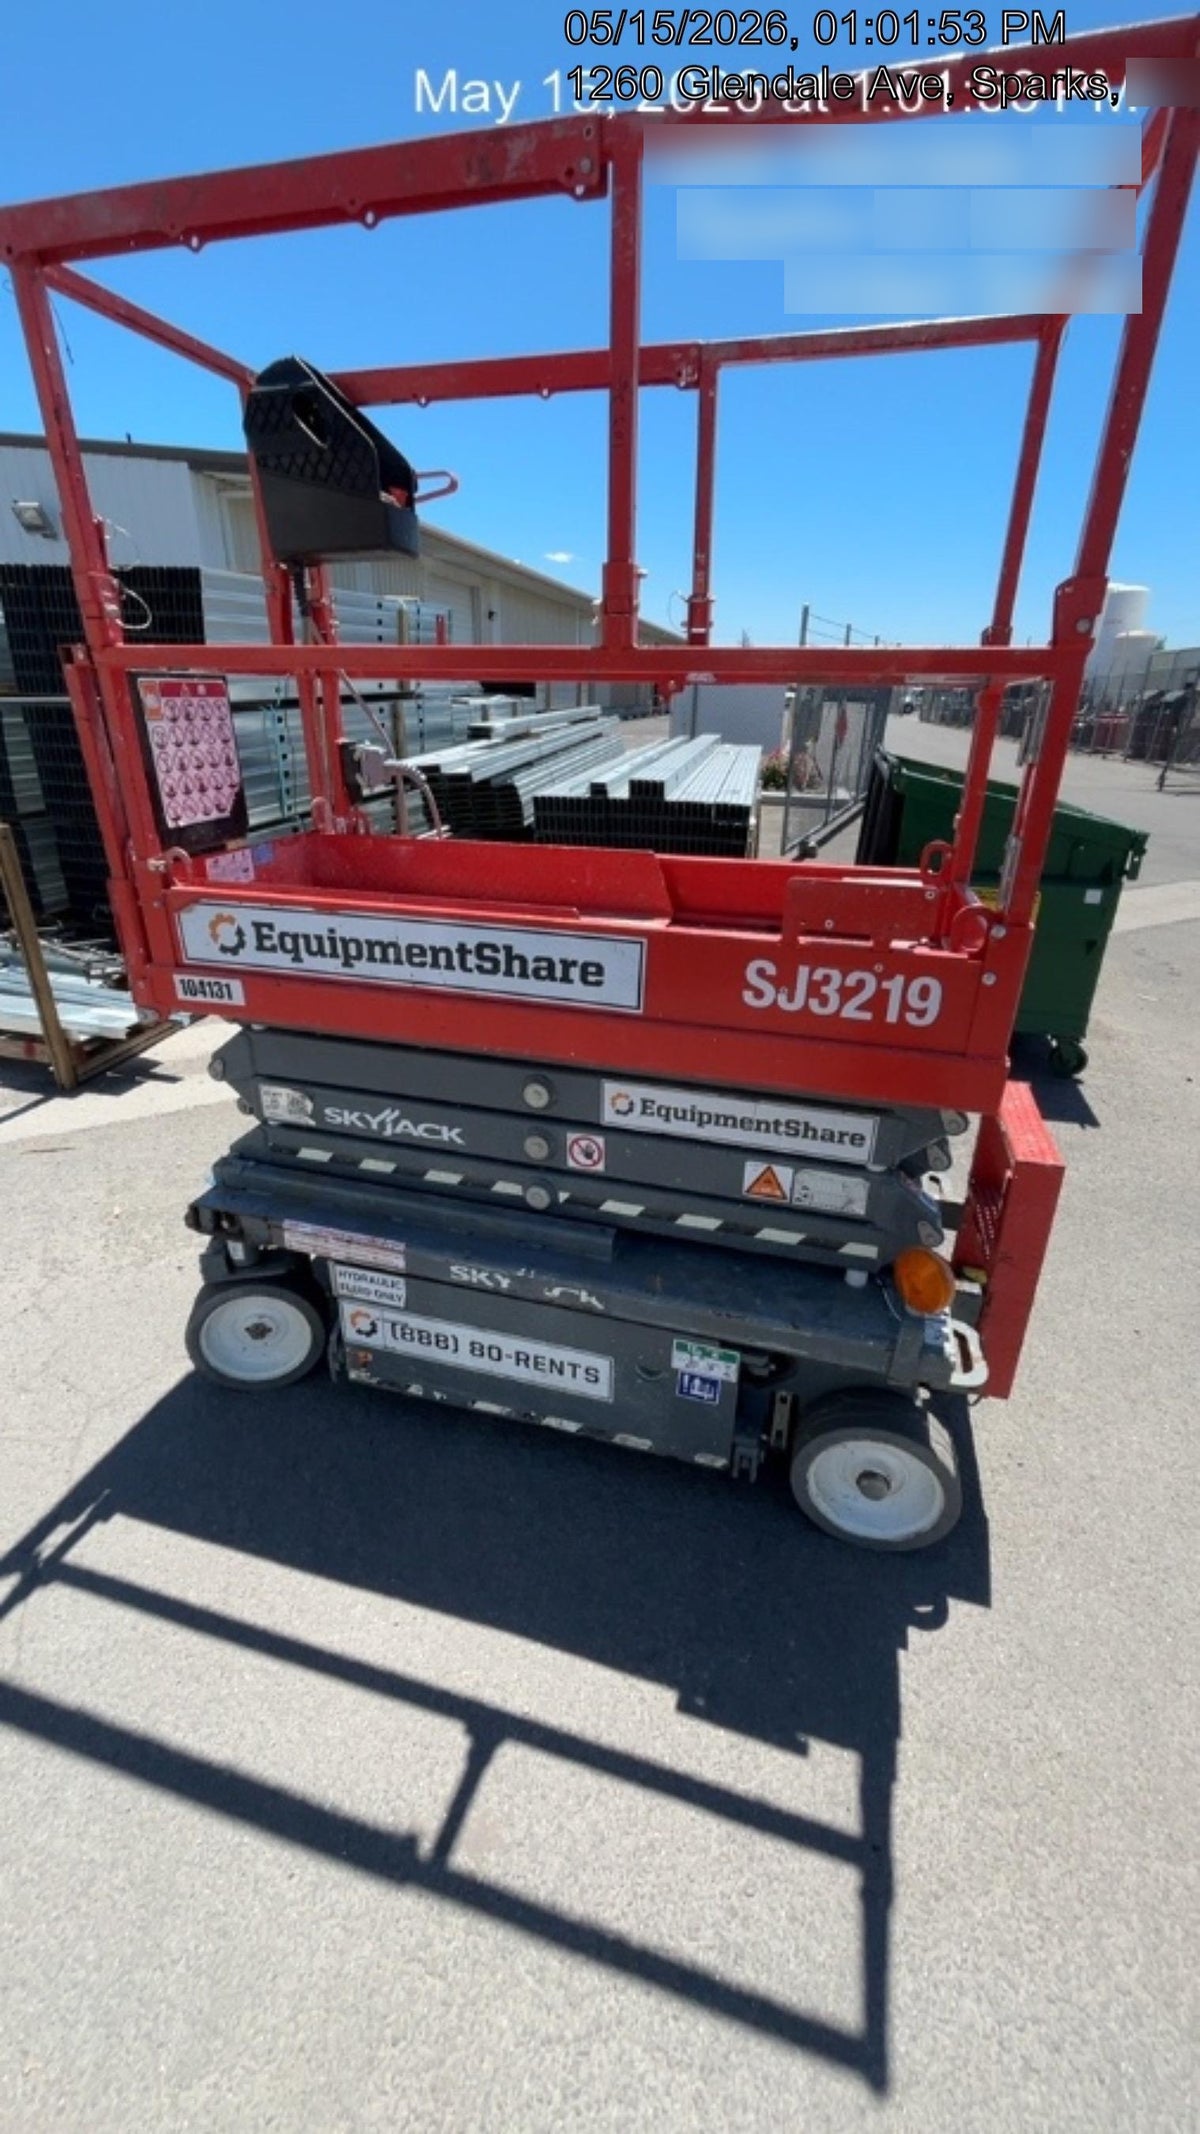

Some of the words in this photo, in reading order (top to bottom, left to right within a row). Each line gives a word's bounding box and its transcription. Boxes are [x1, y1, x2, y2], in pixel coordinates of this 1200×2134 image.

[251, 920, 606, 988] EquipmentShare
[180, 979, 233, 1001] 104131
[742, 959, 942, 1027] SJ3219
[324, 1107, 465, 1145] SKYJACK
[639, 1098, 866, 1148] EquipmentShare
[390, 1321, 459, 1353] (888)
[469, 1340, 600, 1384] 80-RENTS
